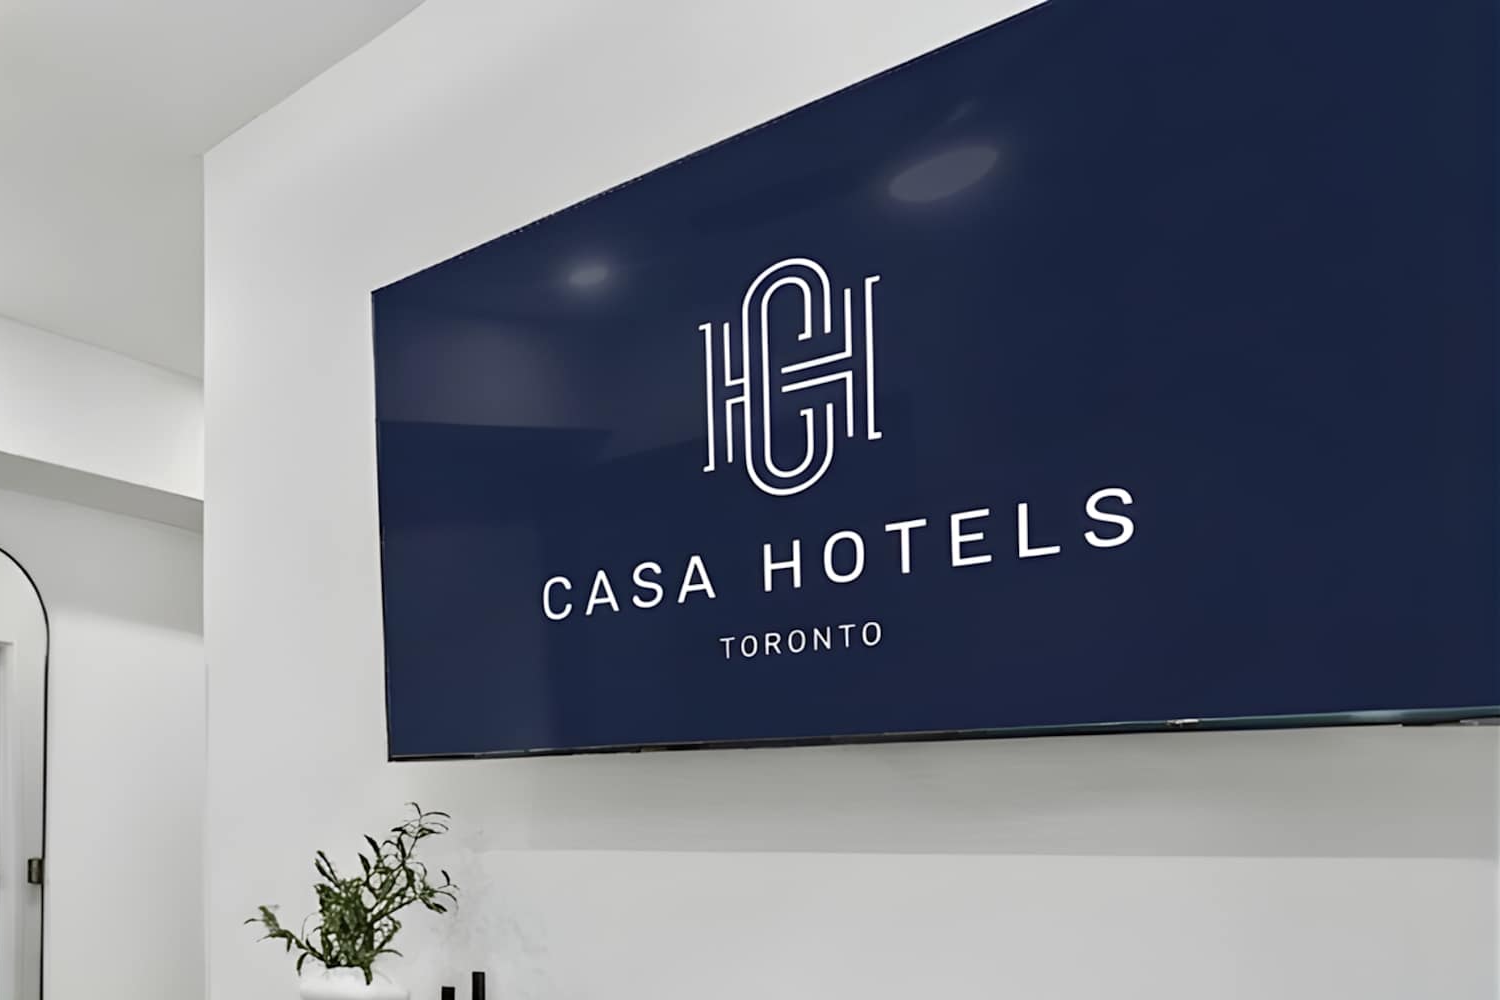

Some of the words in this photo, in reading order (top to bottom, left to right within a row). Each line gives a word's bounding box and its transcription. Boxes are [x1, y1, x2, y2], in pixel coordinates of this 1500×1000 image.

[542, 554, 717, 621] CASA
[762, 486, 1136, 593] HOTELS
[719, 621, 883, 660] TORONTO
